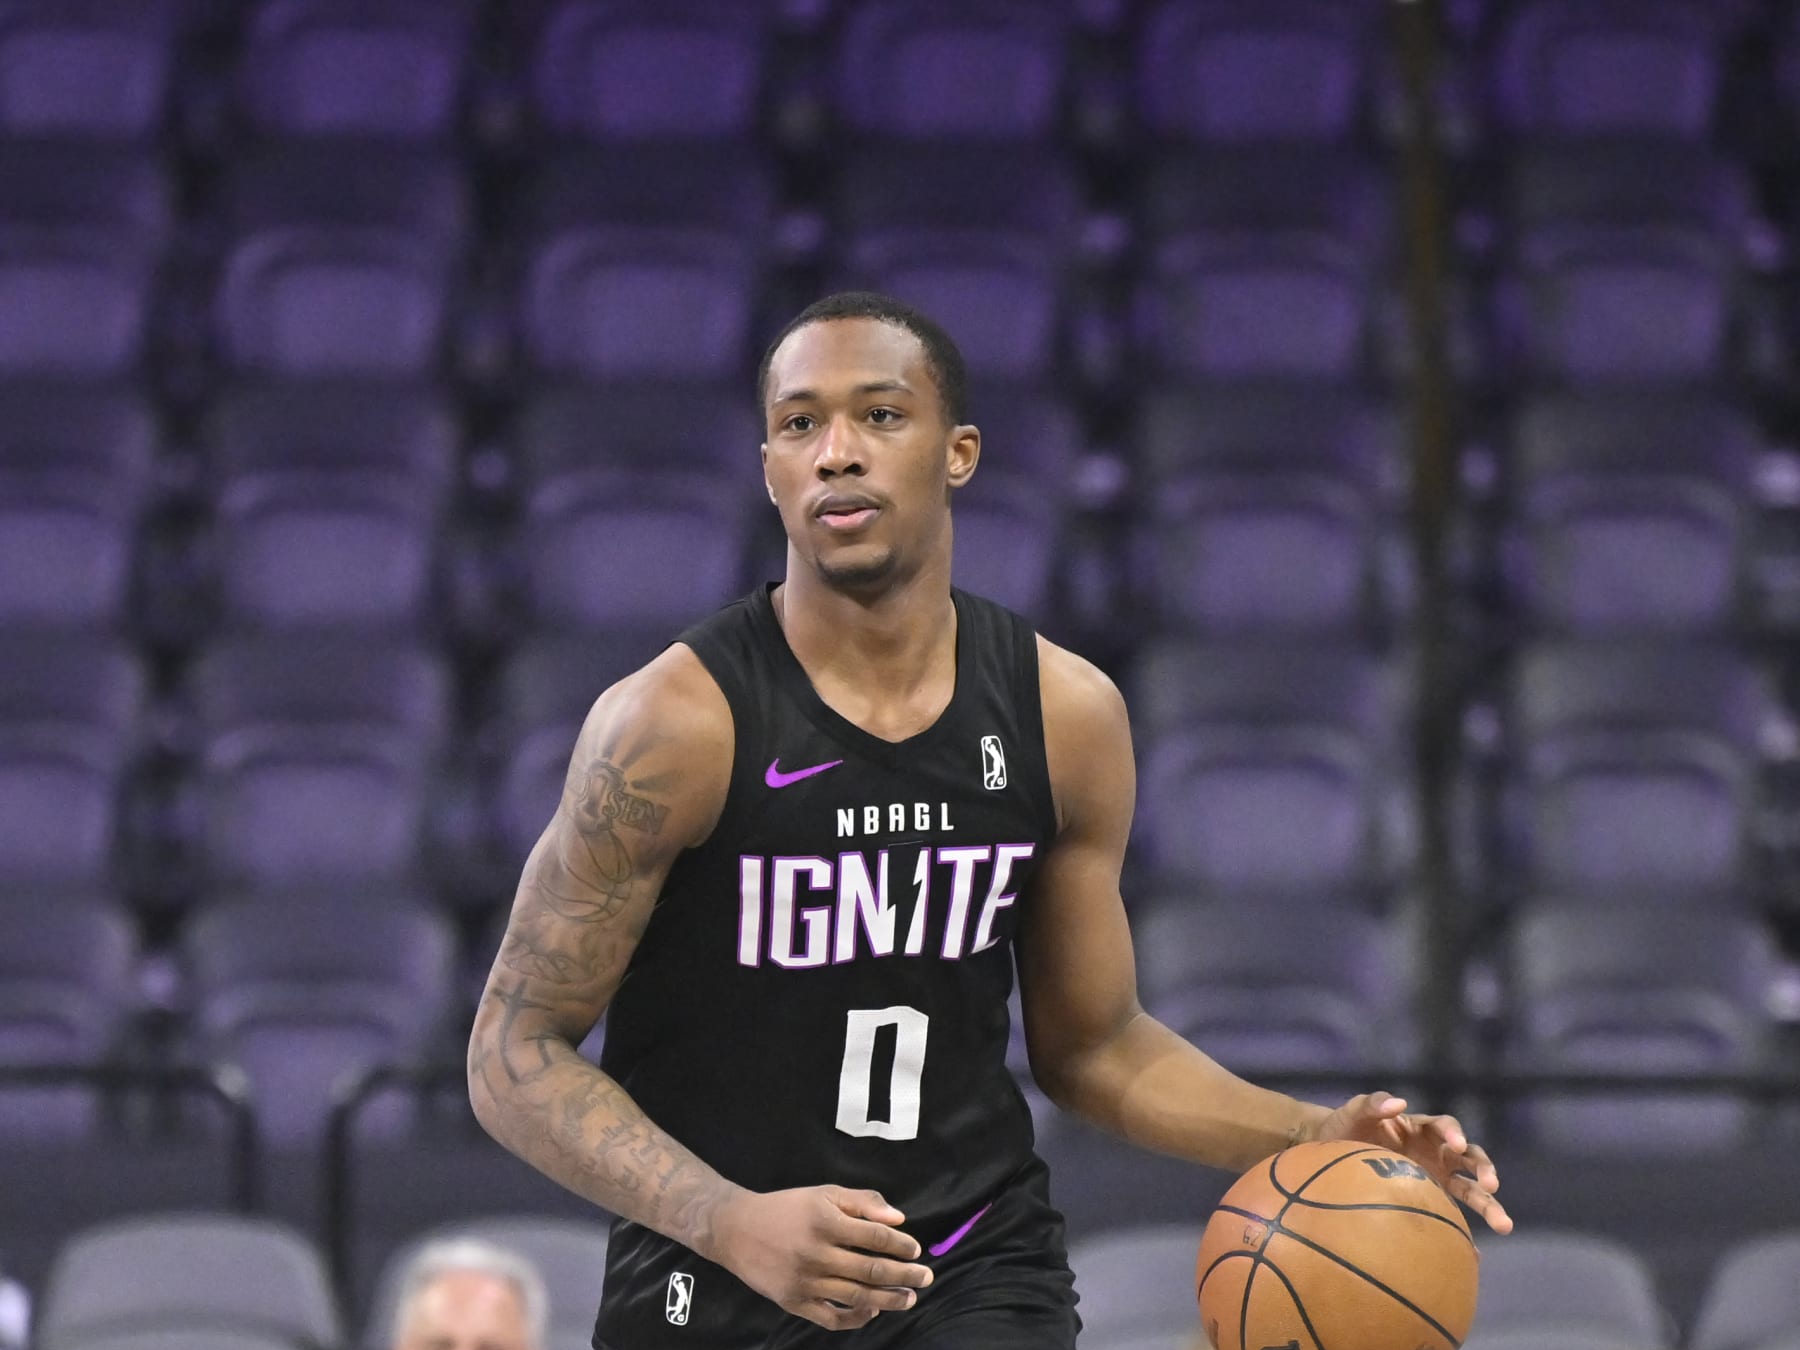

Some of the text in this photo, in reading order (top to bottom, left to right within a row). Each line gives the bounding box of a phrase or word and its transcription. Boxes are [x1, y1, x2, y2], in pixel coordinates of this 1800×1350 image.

[837, 802, 954, 837] NBAGL
[737, 843, 1036, 969] IGNITE
[835, 1005, 929, 1140] 0
